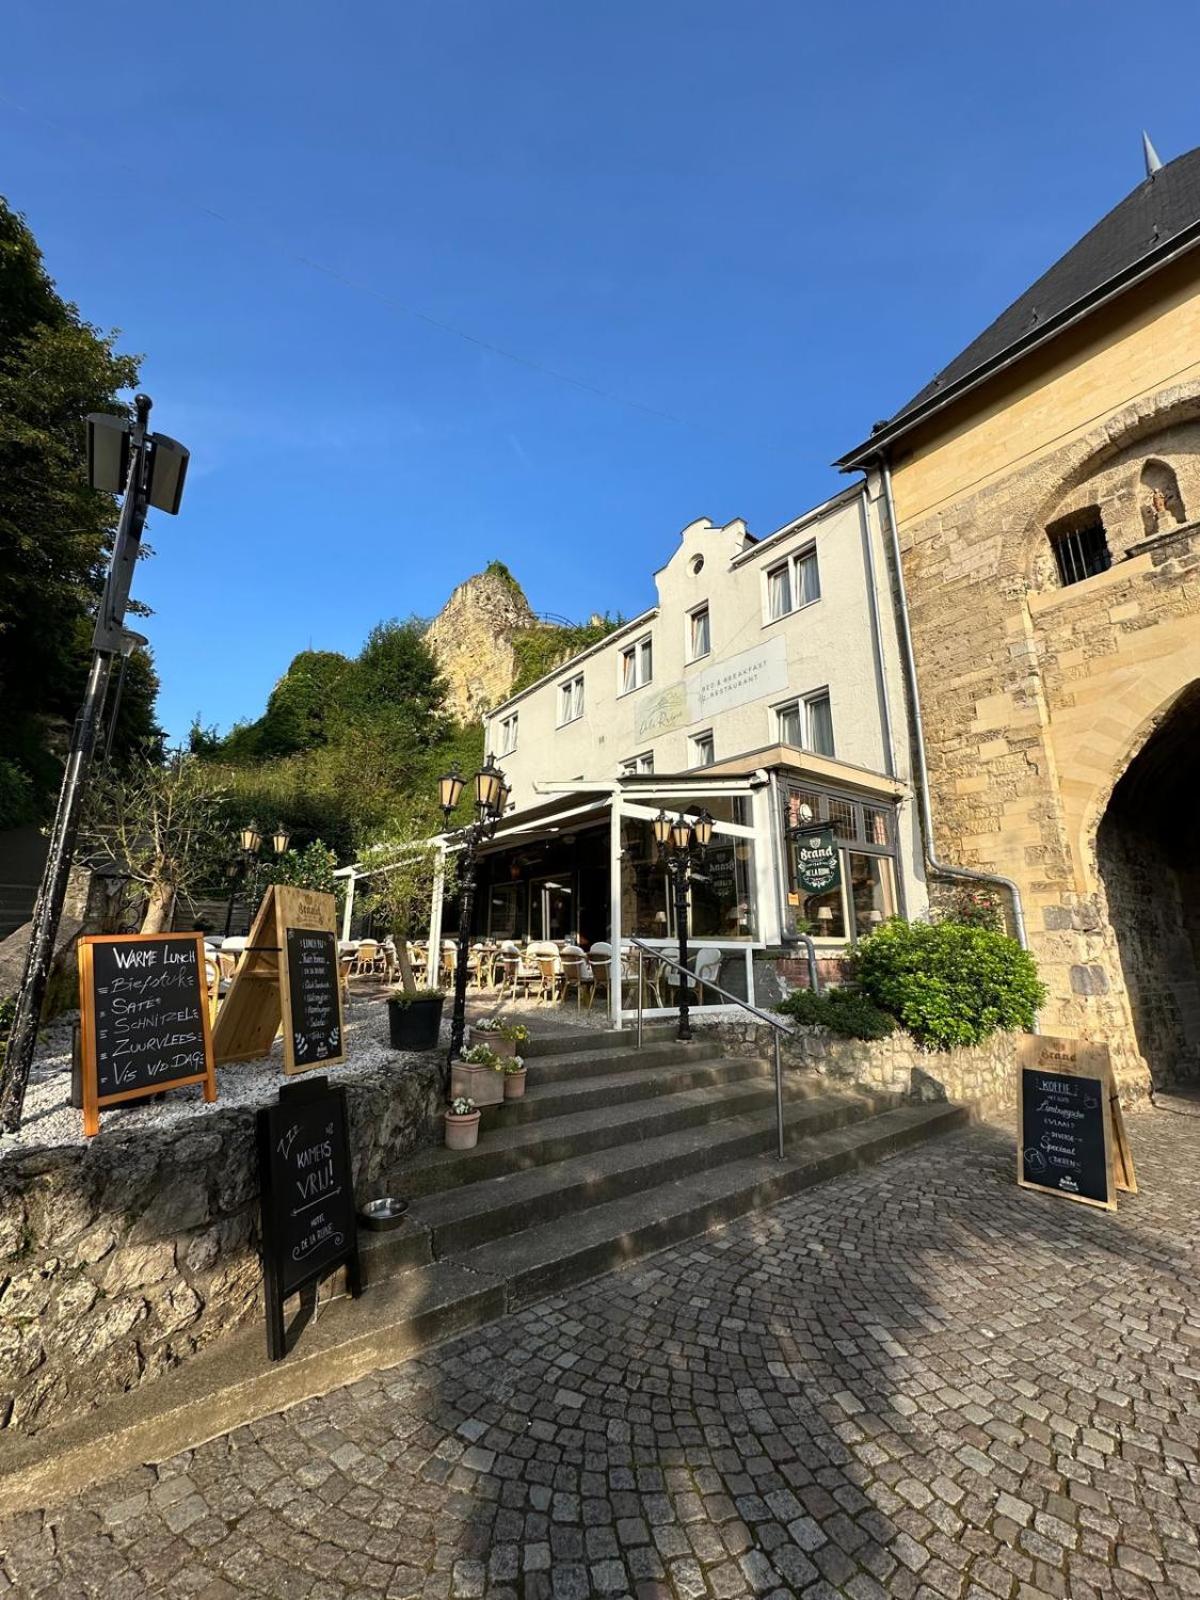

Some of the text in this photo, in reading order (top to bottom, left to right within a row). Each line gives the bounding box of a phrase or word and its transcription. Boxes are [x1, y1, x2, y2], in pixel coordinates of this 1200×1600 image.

[710, 674, 758, 697] RESTAURANT
[800, 845, 833, 862] Brand
[113, 945, 196, 969] WARME LUNCH
[296, 1140, 332, 1169] KAMERS
[296, 1159, 334, 1200] VRIJ!
